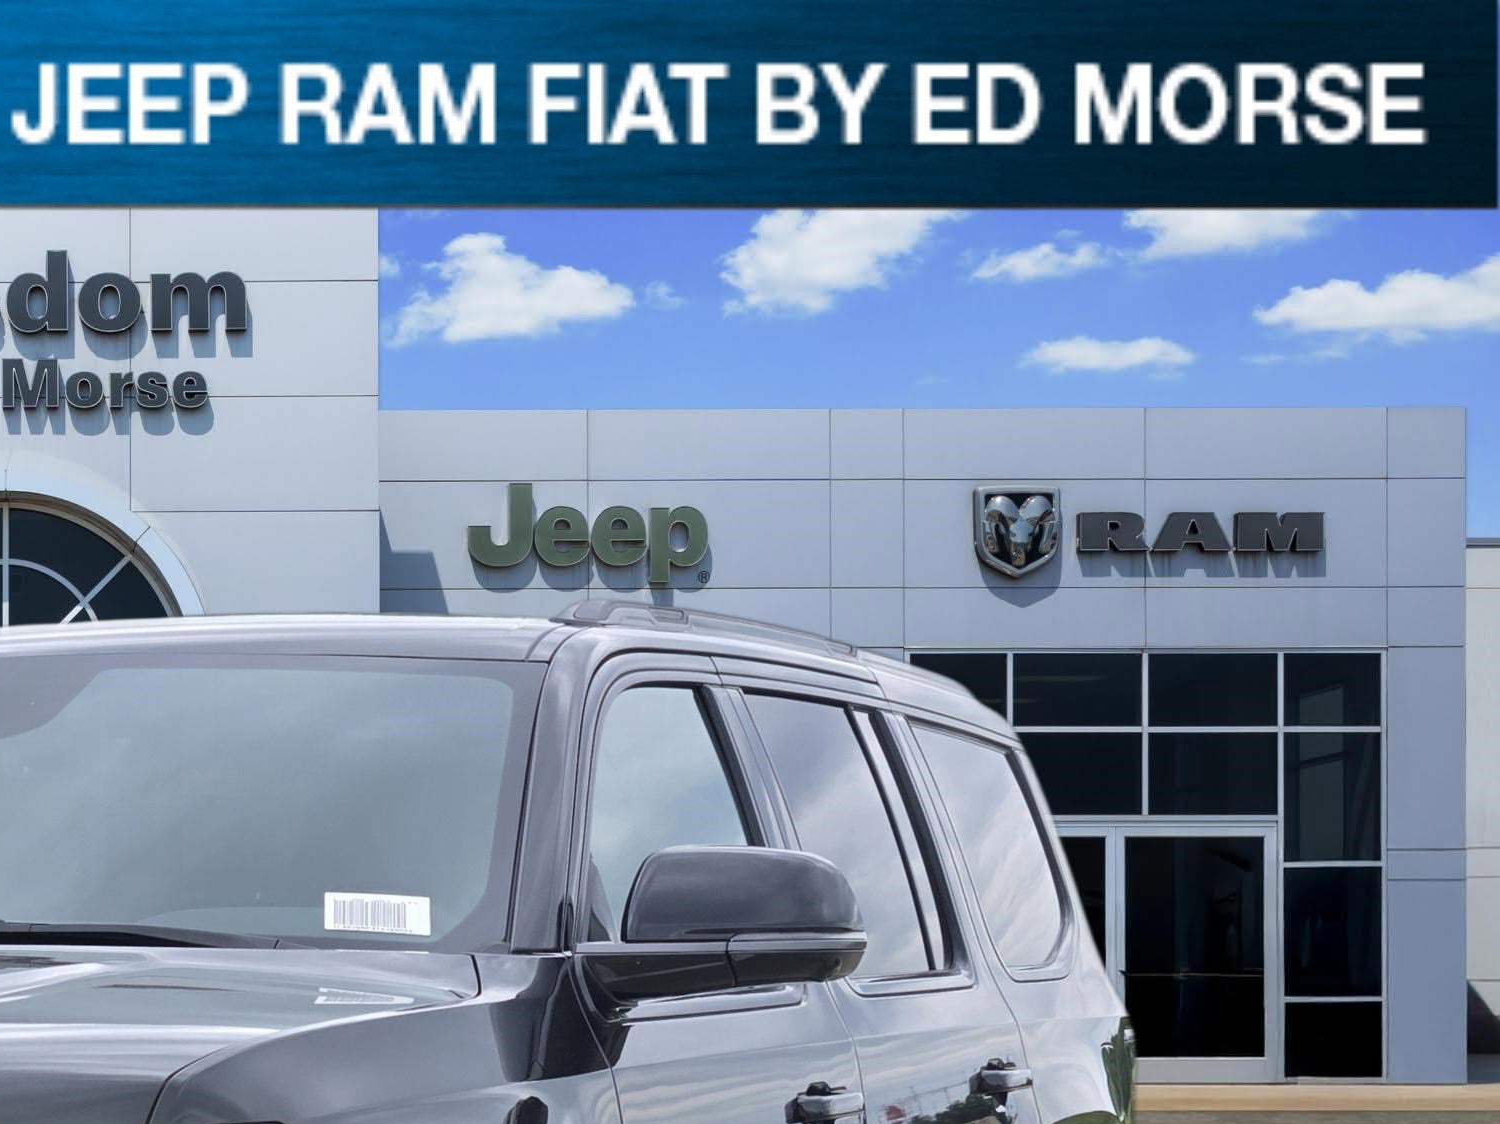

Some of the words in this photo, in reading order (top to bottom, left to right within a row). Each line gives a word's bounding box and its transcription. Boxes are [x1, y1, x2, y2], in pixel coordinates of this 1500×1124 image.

[1, 357, 210, 409] Morse
[466, 482, 709, 585] Jeep
[1076, 510, 1327, 553] RAM
